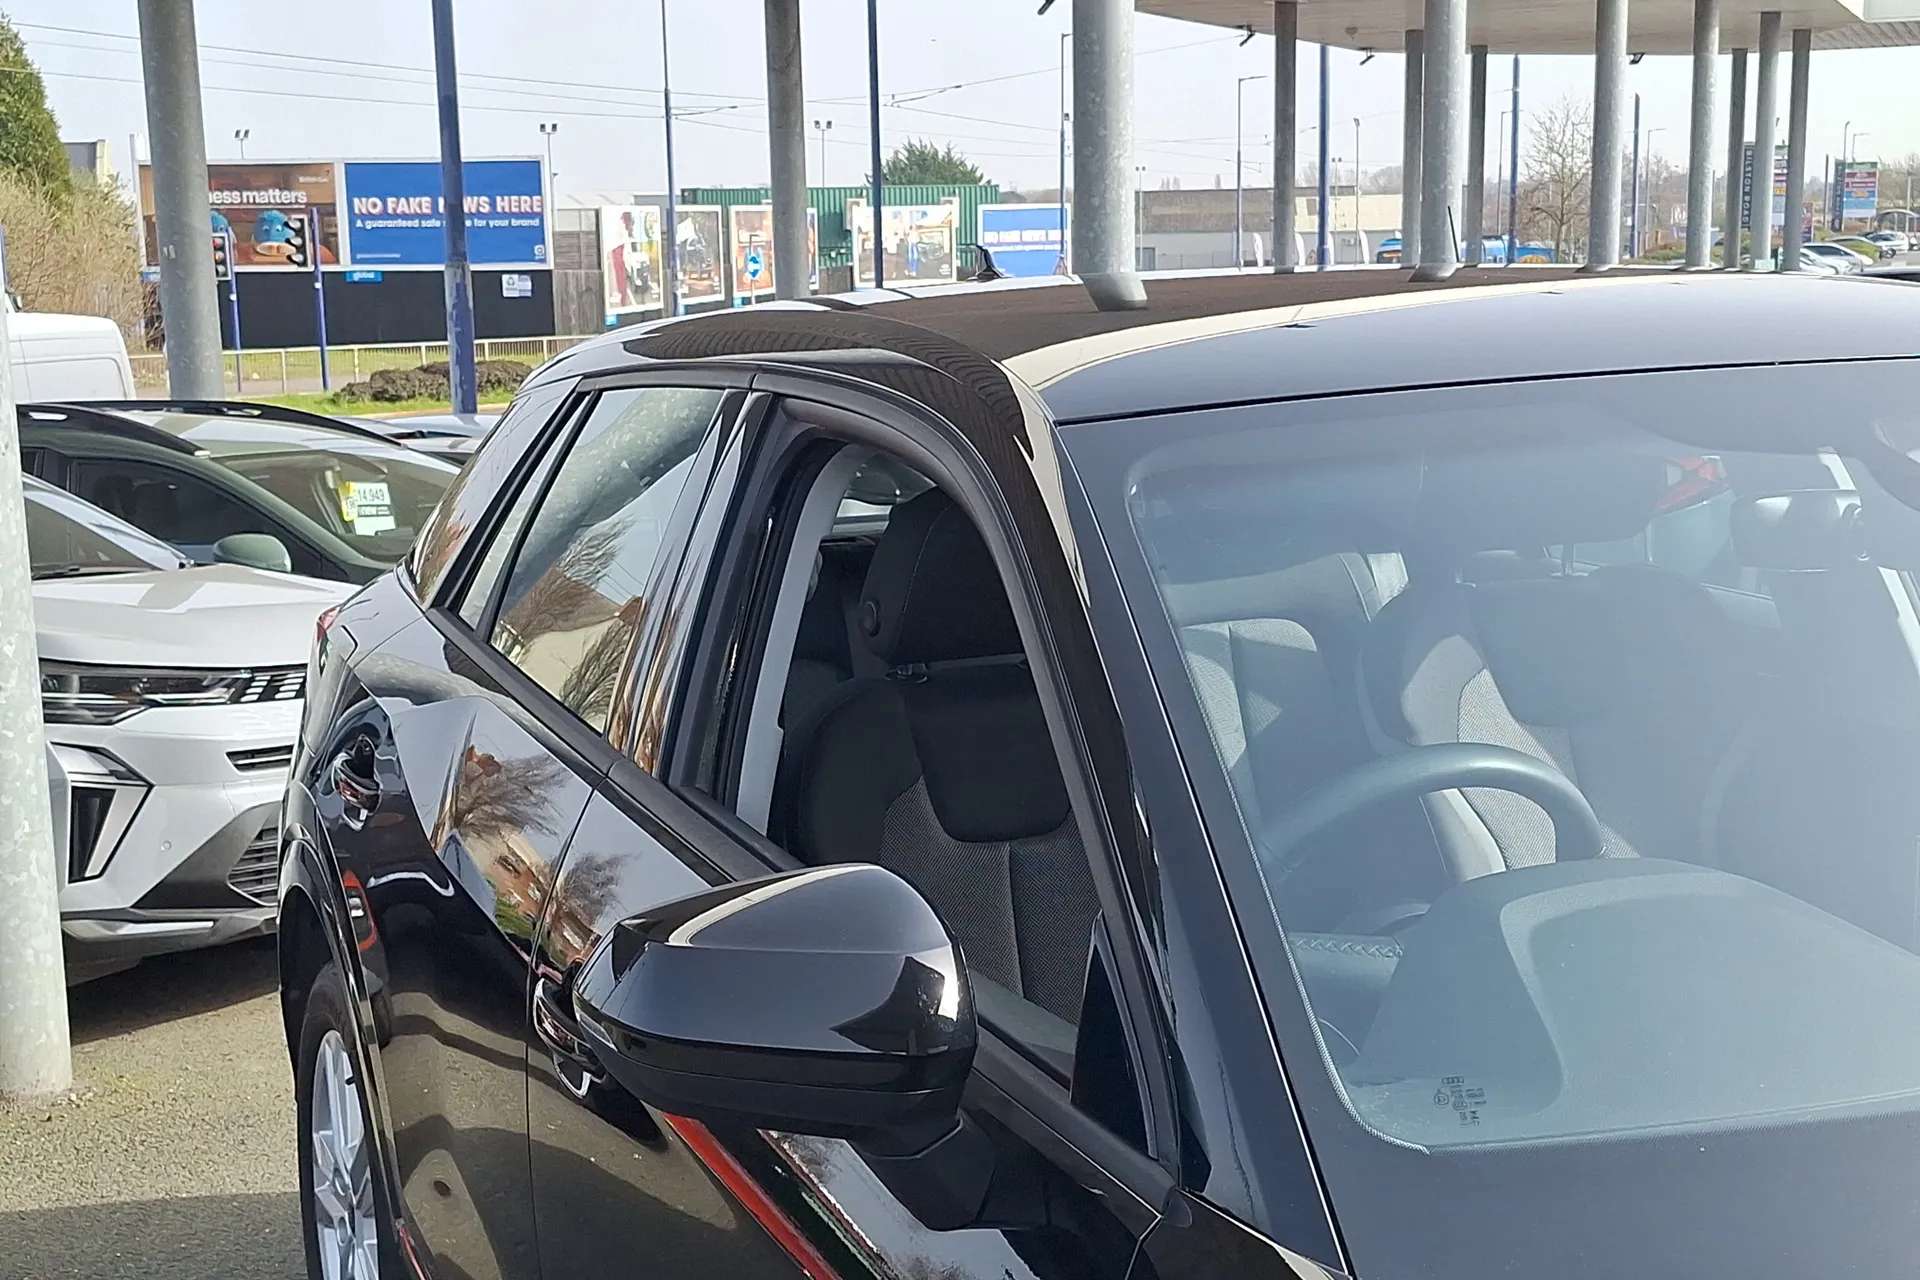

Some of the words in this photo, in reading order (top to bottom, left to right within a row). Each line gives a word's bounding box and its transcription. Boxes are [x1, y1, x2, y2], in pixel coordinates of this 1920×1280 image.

[1744, 150, 1753, 192] BILSTON
[242, 188, 307, 204] matters
[353, 196, 384, 215] NO
[387, 196, 432, 215] FAKE
[438, 196, 490, 214] NWS
[496, 195, 543, 214] HERE
[355, 219, 363, 228] A
[365, 219, 420, 229] guaranteed
[421, 218, 441, 228] safe
[474, 218, 487, 227] for
[488, 219, 509, 229] your
[511, 218, 540, 227] brand
